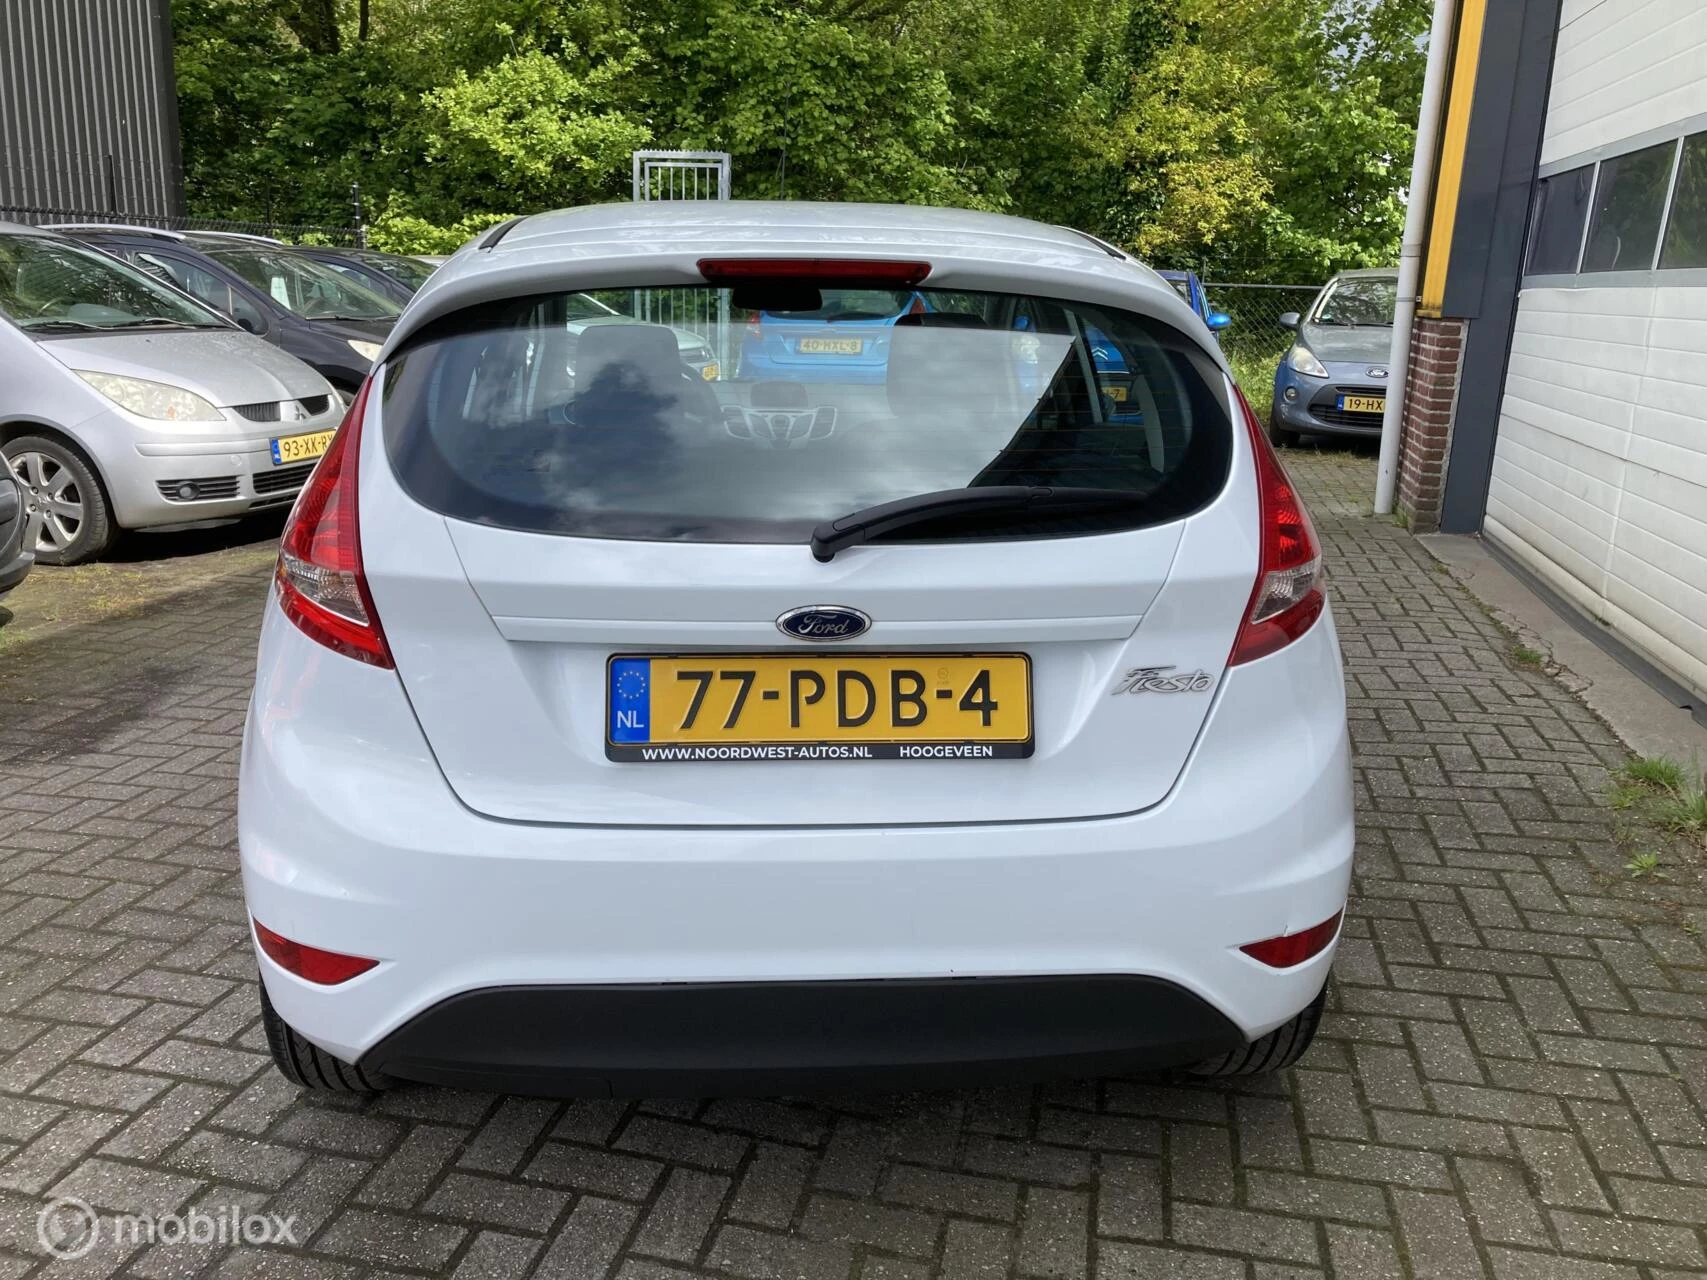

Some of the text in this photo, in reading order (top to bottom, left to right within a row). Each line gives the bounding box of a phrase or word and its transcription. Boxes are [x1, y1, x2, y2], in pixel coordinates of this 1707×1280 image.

[798, 614, 850, 634] Ford
[676, 669, 998, 729] 77-PDB-4
[617, 710, 644, 728] NL
[642, 745, 993, 760] WWW.NOORDWEST-AUTOS.NL HOOGEVEEN
